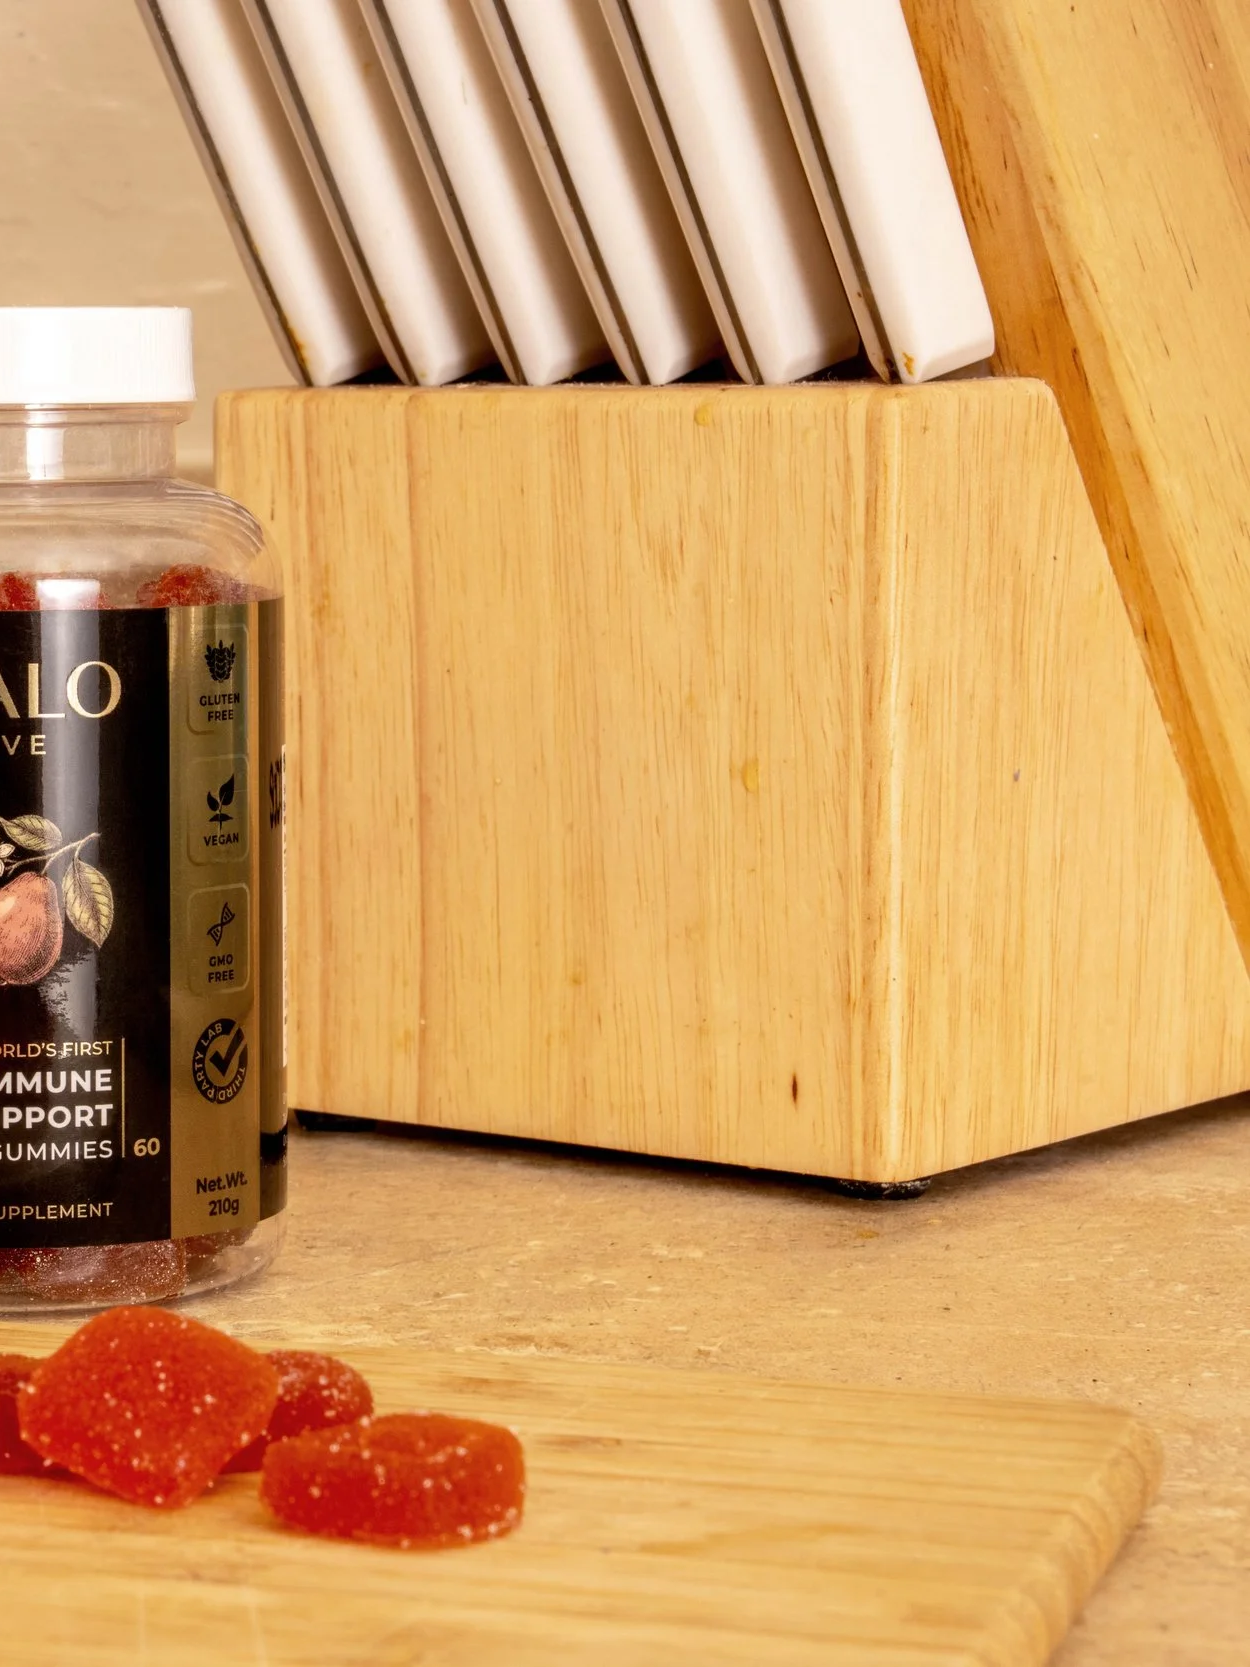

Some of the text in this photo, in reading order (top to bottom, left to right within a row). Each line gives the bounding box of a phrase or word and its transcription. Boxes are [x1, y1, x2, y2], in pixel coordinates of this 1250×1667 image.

[199, 693, 241, 706] GLUTEN
[207, 709, 235, 722] FREE
[203, 832, 240, 847] VEGAN
[208, 954, 234, 967] GMO
[207, 969, 235, 983] FREE
[62, 1041, 113, 1057] FIRST
[194, 1022, 246, 1101] THIRD PARTY LAB
[133, 1138, 161, 1157] 60
[196, 1173, 248, 1195] Net.Wt.
[208, 1198, 240, 1217] 210g
